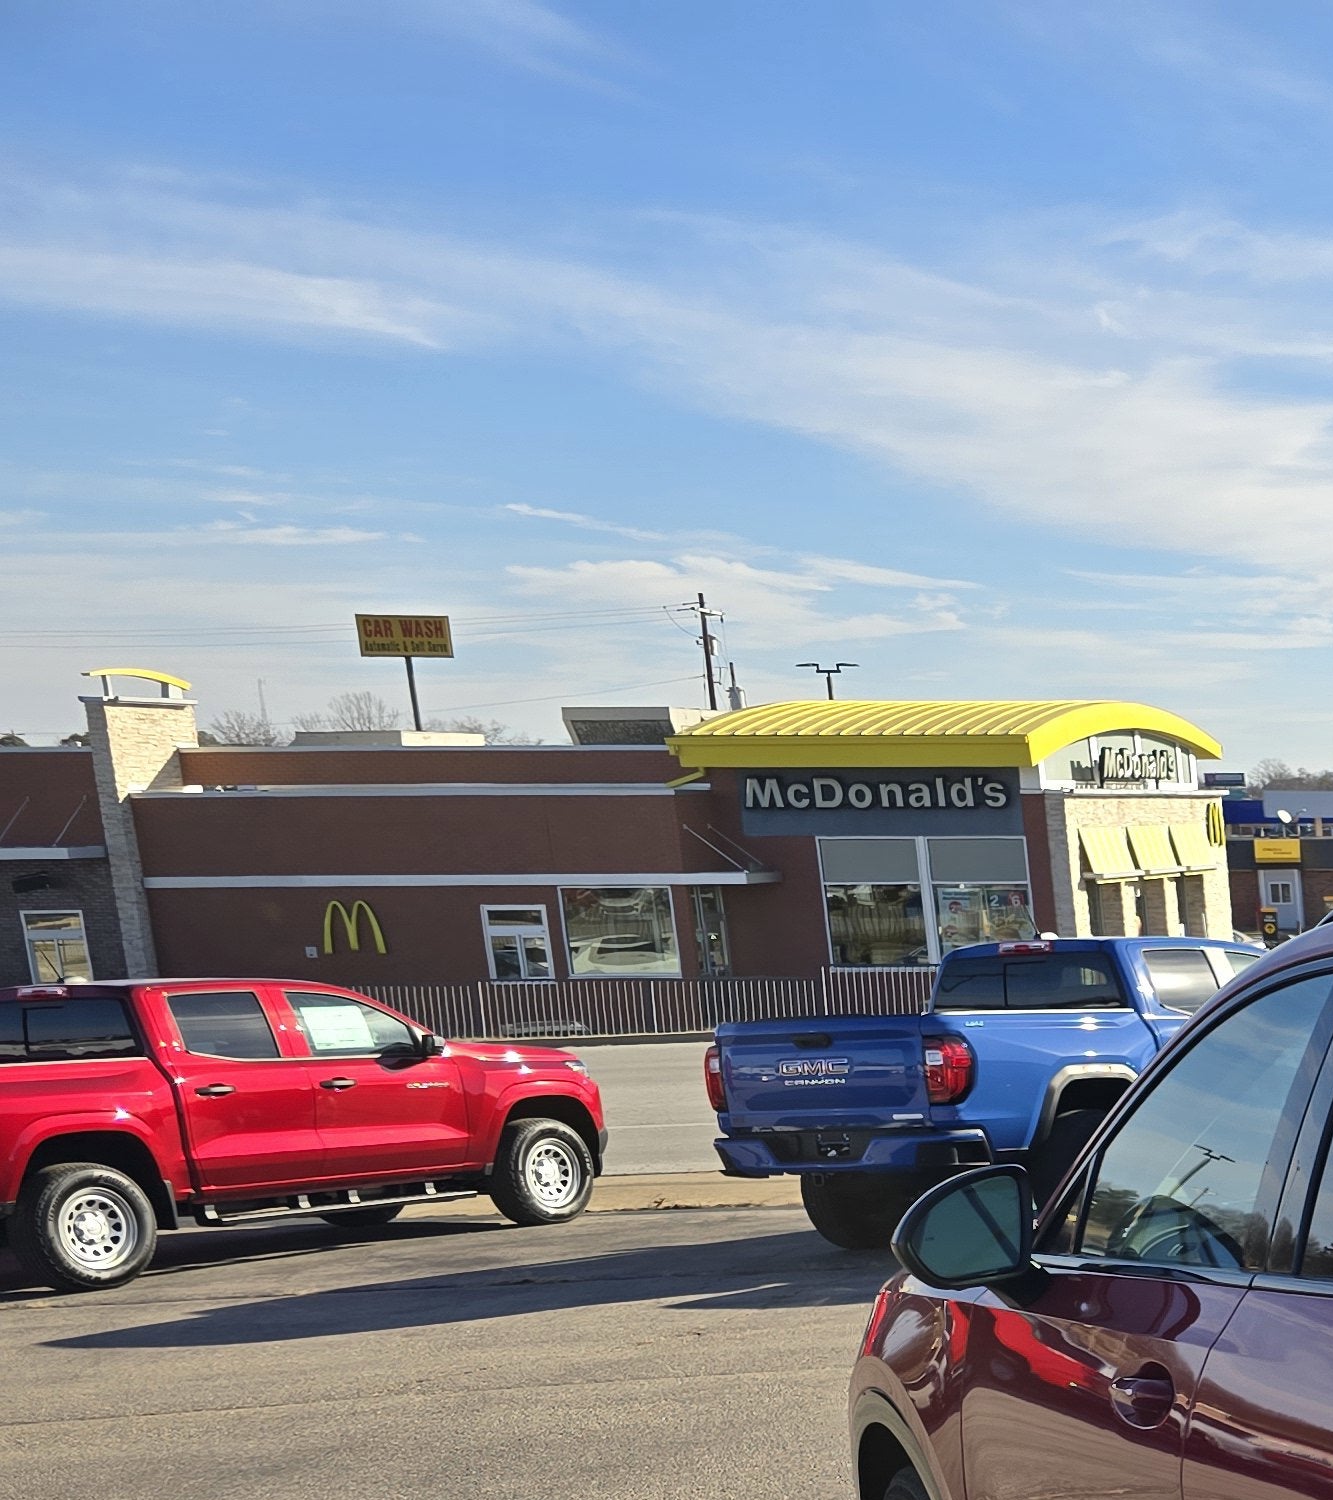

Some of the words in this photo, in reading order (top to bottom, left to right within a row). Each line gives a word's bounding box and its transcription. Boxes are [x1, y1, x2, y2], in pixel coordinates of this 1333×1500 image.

[362, 618, 394, 638] CAR
[399, 619, 445, 639] WASH
[364, 640, 400, 652] Automatic
[402, 641, 409, 652] &
[745, 777, 1008, 809] McDonald's
[780, 1058, 851, 1077] GMC
[784, 1078, 846, 1086] CANYON
